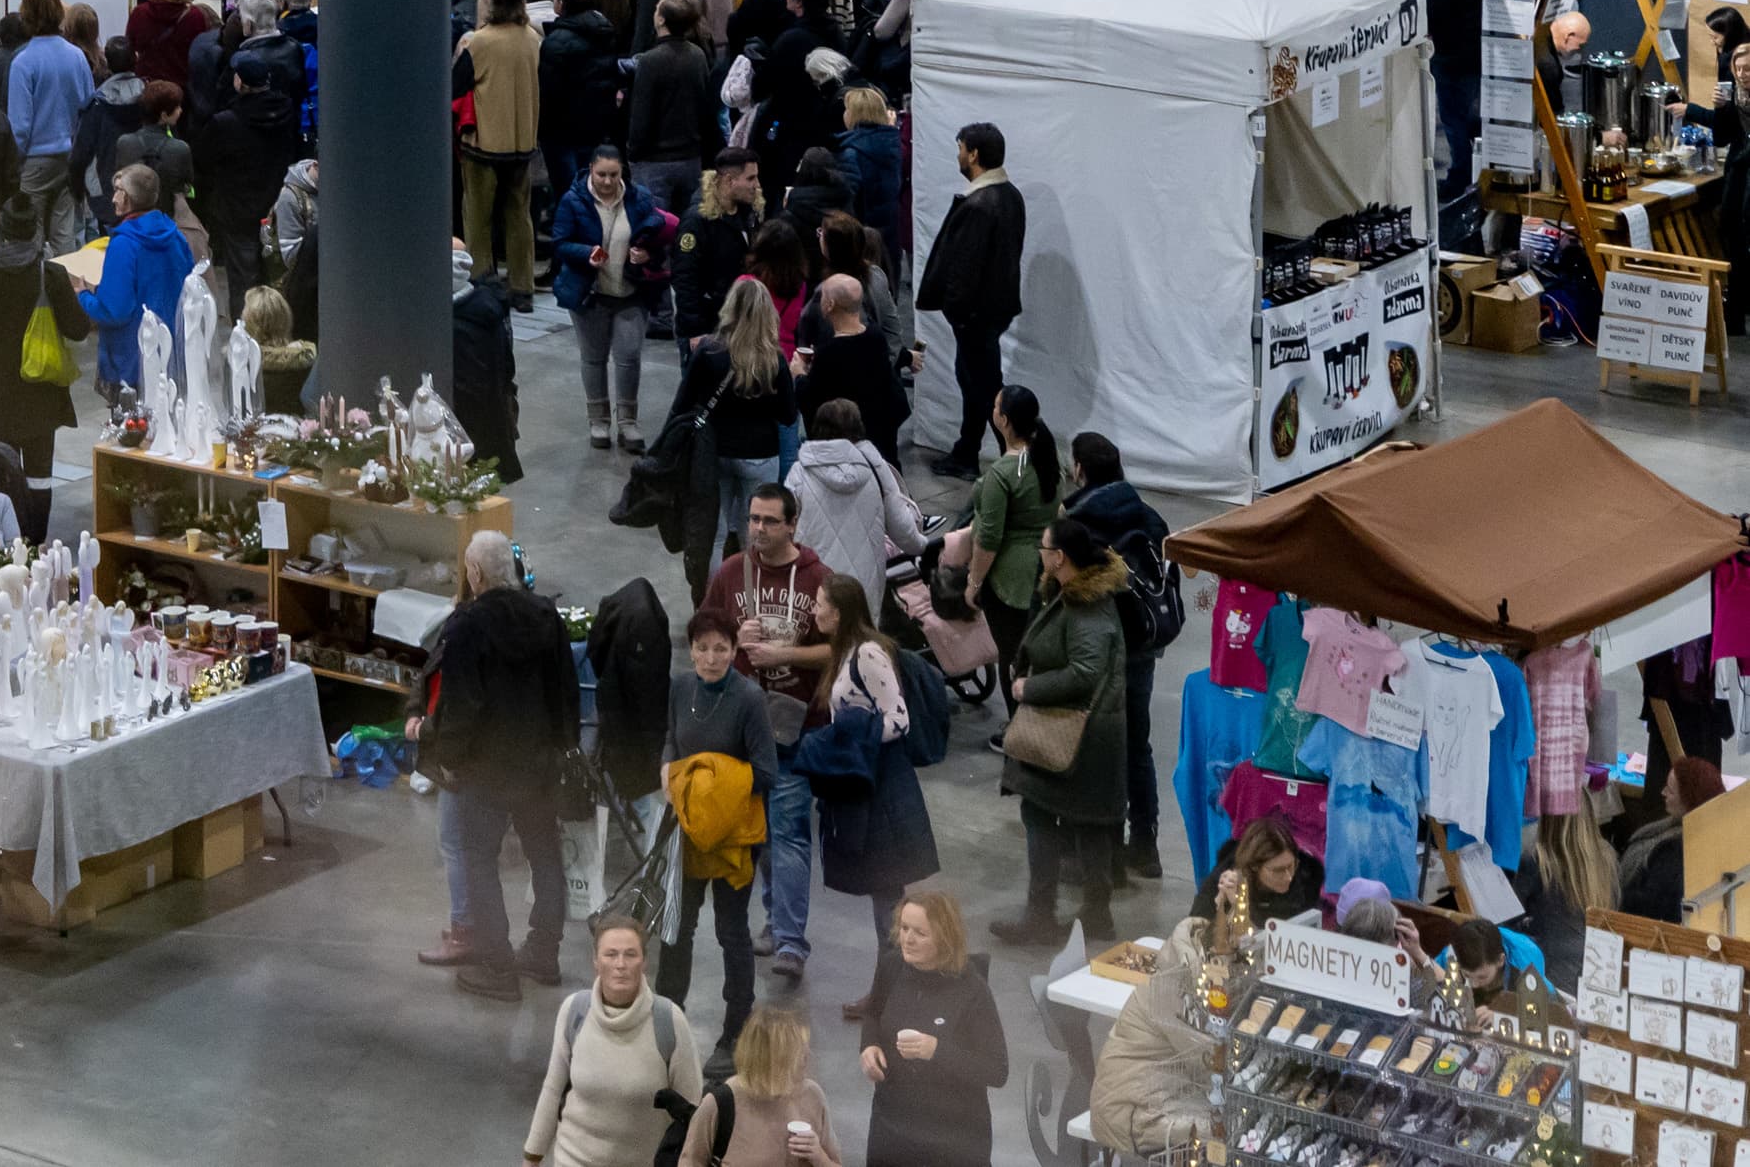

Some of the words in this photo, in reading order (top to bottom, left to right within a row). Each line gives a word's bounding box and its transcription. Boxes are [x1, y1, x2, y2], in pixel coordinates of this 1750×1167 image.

[1660, 289, 1703, 303] DAVIDŮV
[1386, 294, 1422, 319] zdarma
[1617, 297, 1642, 309] VÍNO
[1667, 306, 1694, 318] PUNČ
[1664, 350, 1691, 363] PUNČ
[1268, 934, 1362, 981] MAGNETY
